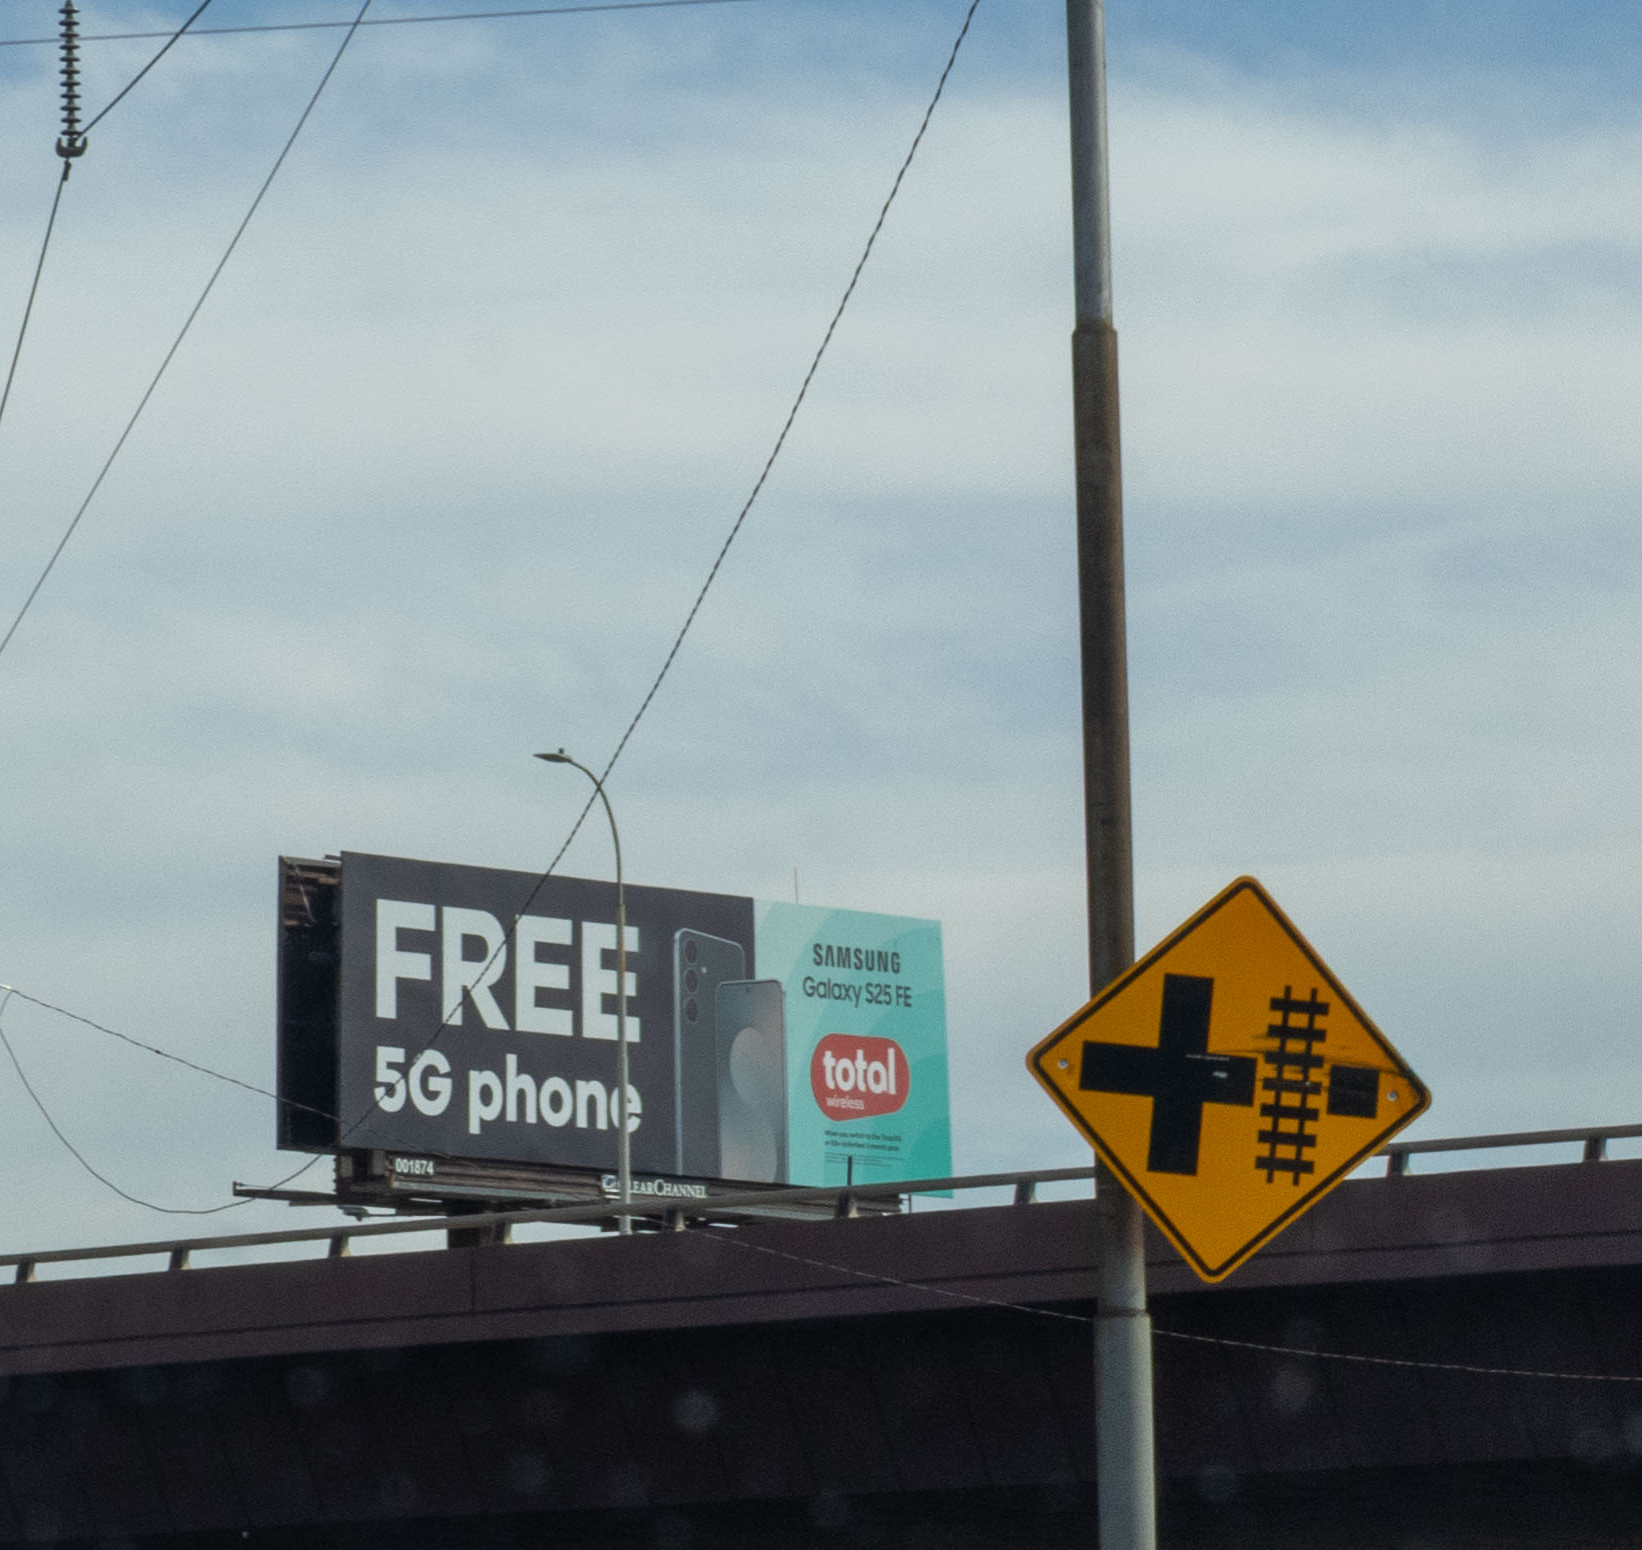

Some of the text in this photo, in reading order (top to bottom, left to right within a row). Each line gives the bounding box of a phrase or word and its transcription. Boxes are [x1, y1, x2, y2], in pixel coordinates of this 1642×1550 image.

[376, 898, 642, 1043] FREE
[812, 943, 901, 975] SAMSUNG
[803, 975, 913, 1009] Galaxy S25 FE
[822, 1047, 898, 1095] total
[374, 1045, 643, 1135] 5G phone
[825, 1094, 866, 1111] wireless
[395, 1157, 435, 1176] 001874
